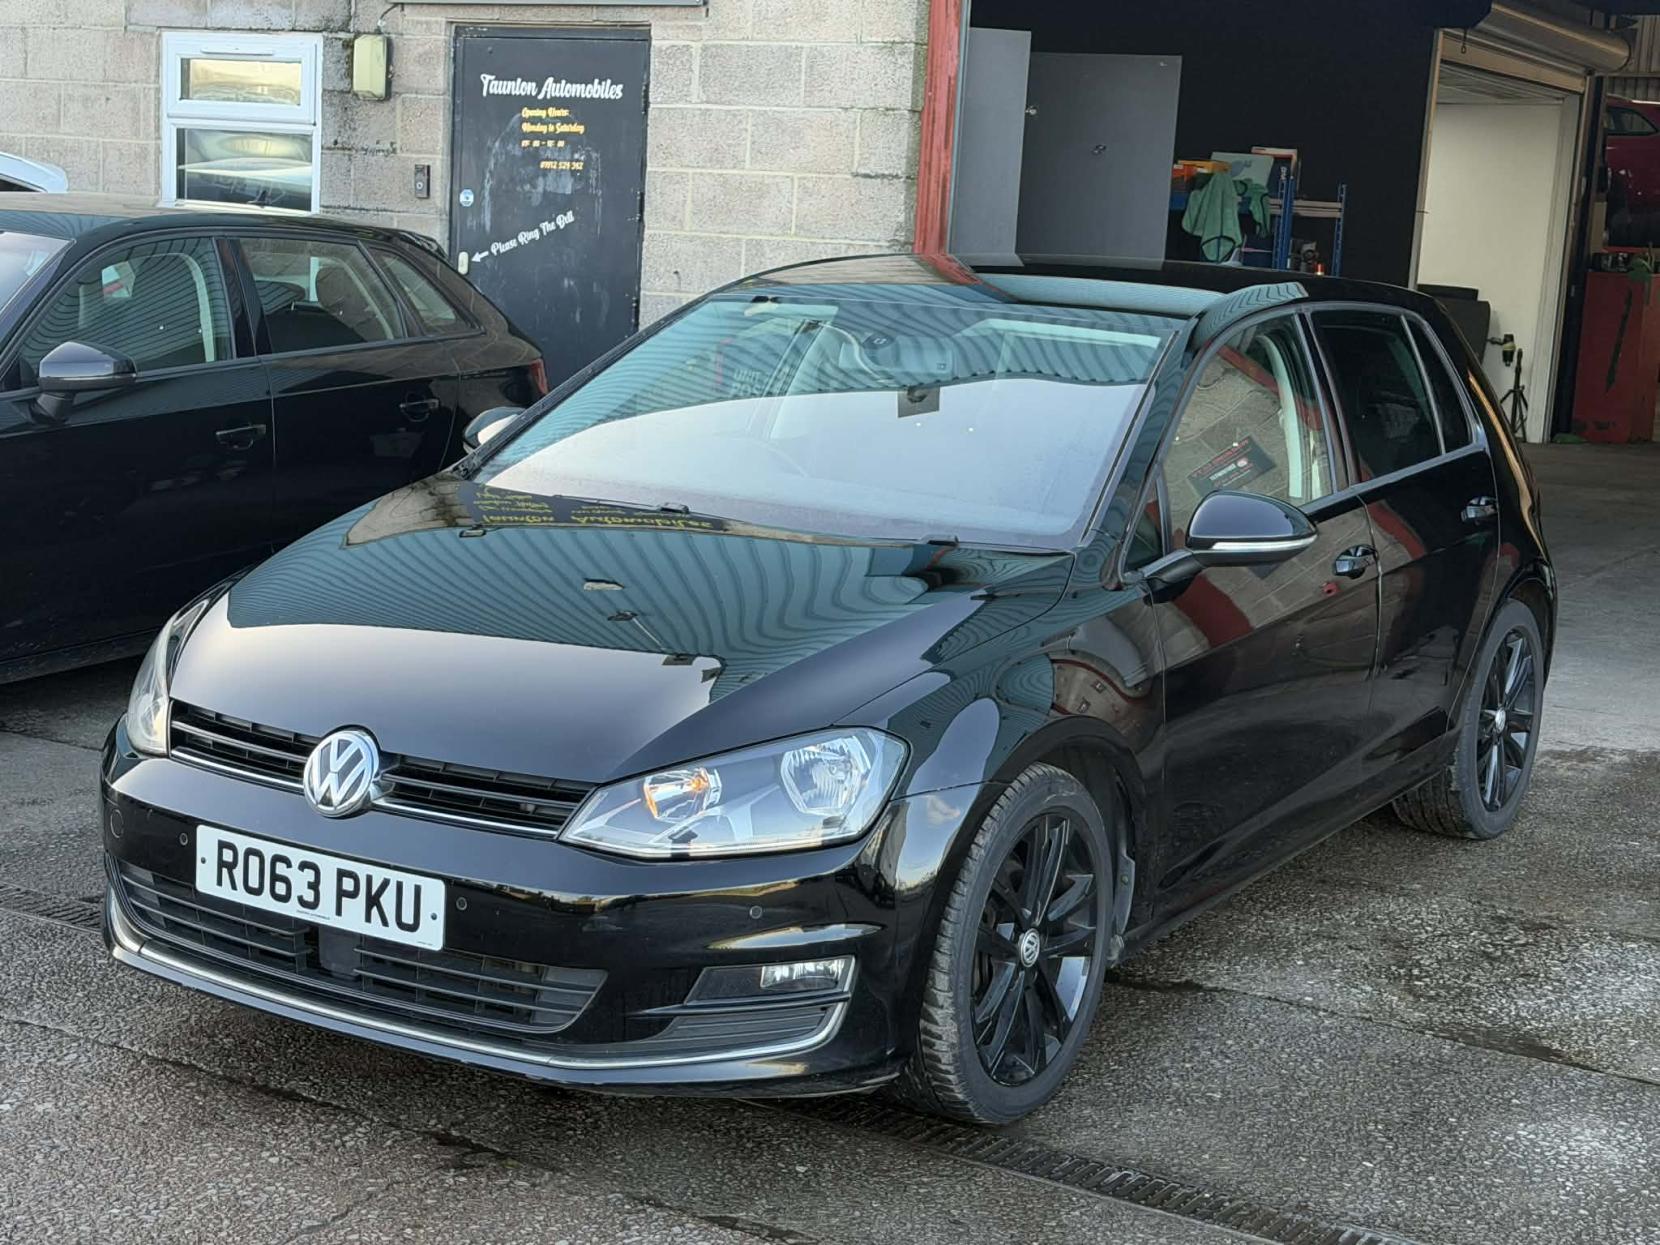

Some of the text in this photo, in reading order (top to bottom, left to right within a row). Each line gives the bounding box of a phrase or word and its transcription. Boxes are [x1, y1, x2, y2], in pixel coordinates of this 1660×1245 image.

[480, 73, 624, 100] Taunton Automobiles
[521, 107, 546, 119] Opening
[521, 122, 547, 134] Monday
[555, 122, 585, 134] Saturday
[490, 210, 575, 256] Please Ring The Bell
[216, 839, 422, 933] RO63 PKU
